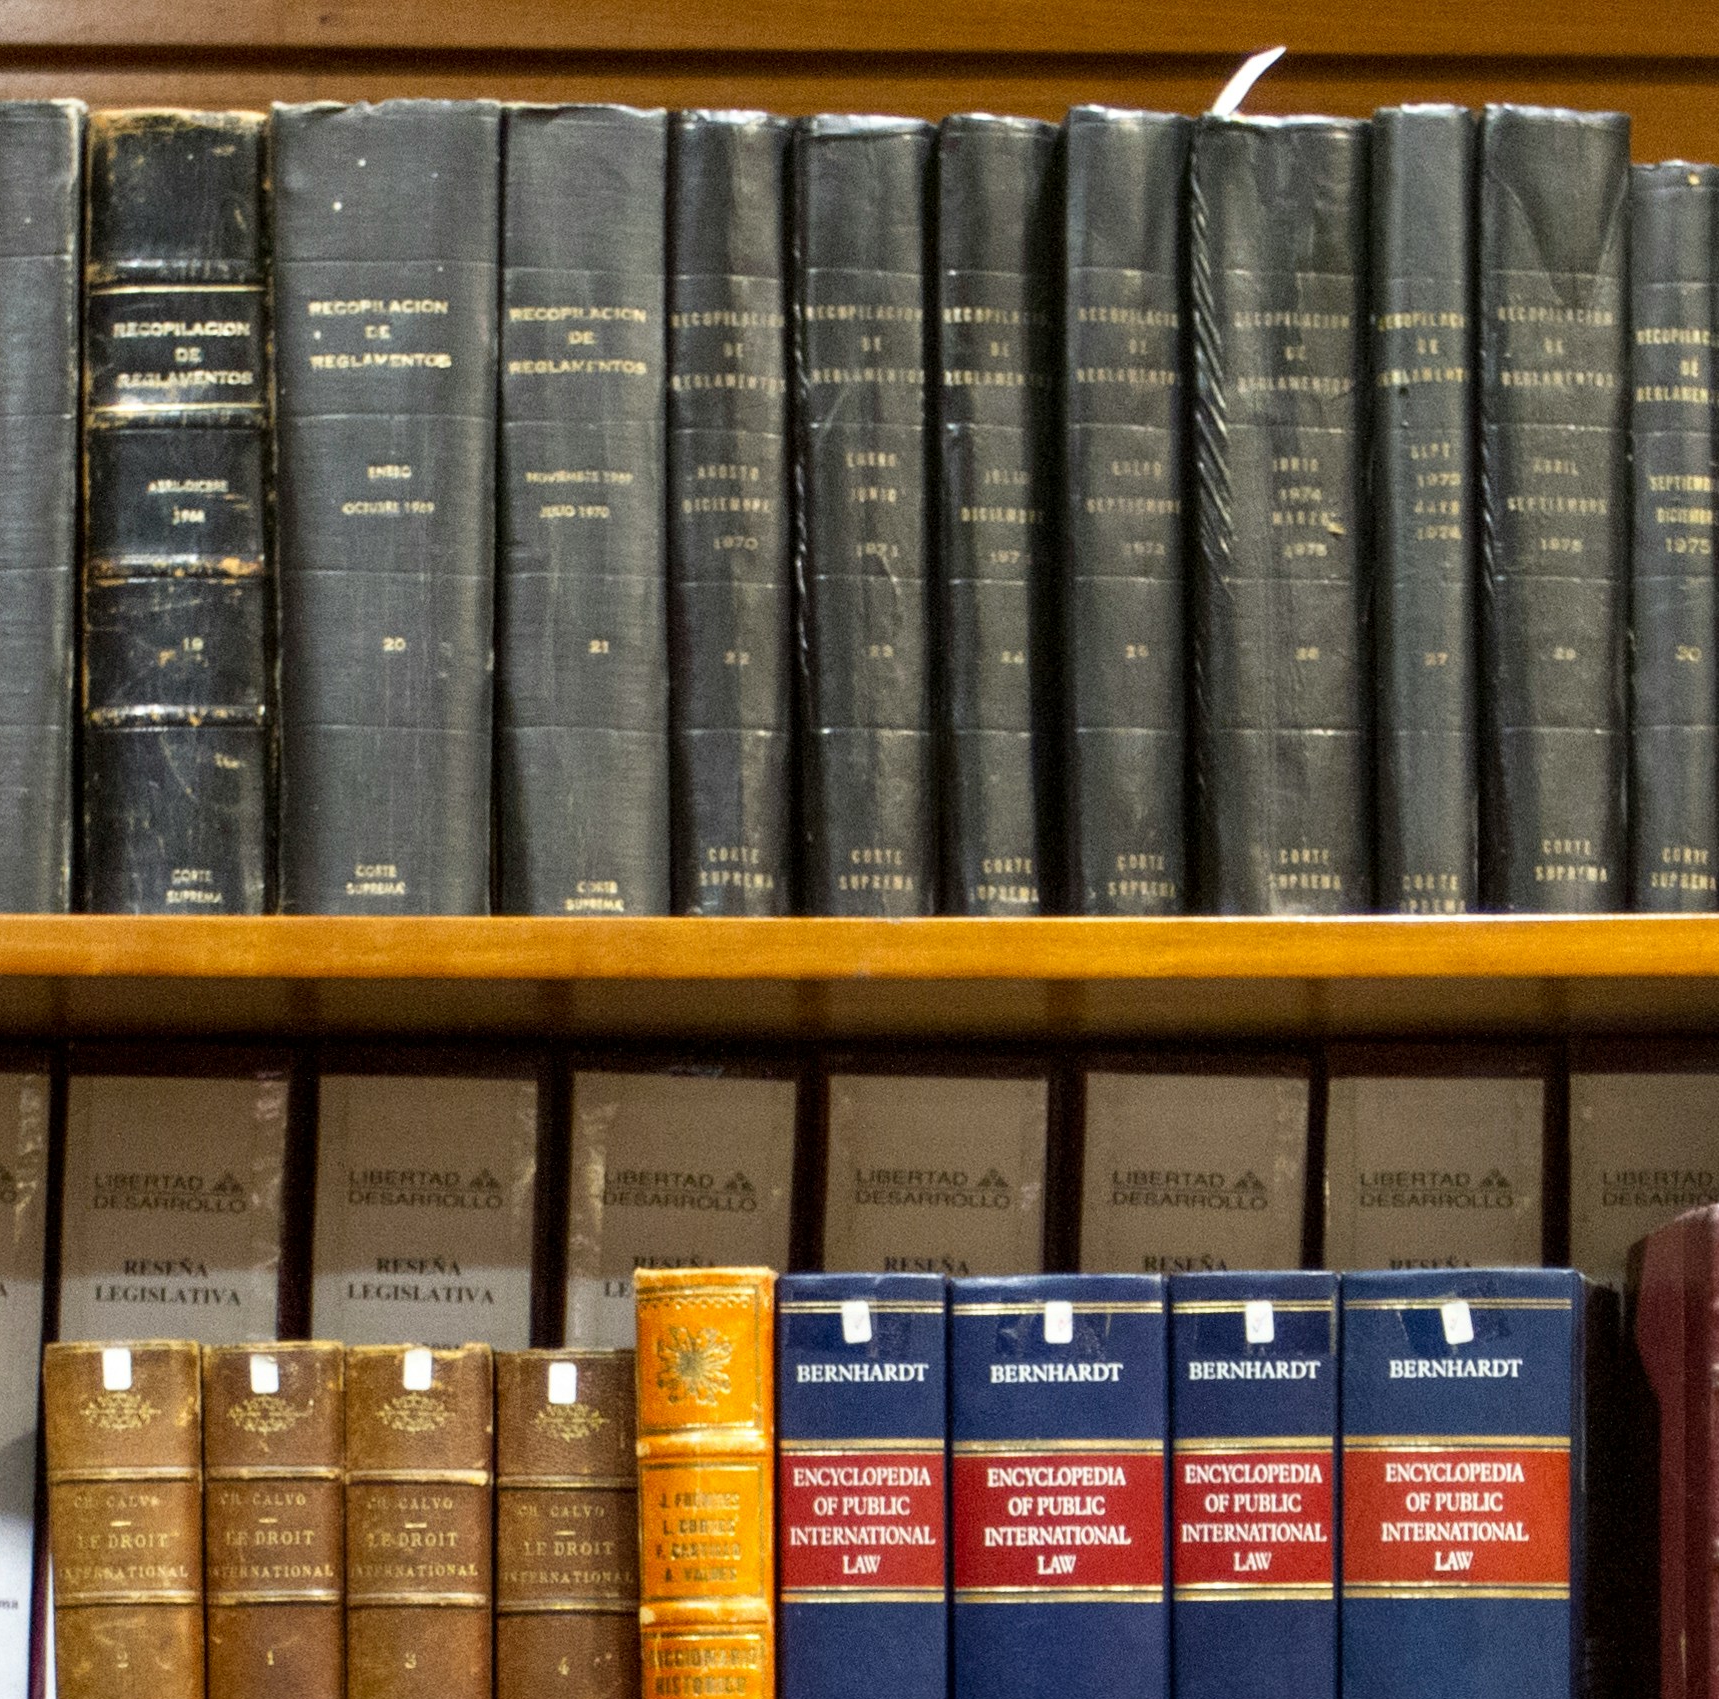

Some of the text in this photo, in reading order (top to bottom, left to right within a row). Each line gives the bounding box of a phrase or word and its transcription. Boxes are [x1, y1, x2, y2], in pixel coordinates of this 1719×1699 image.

[384, 638, 406, 651] 20
[797, 1363, 929, 1382] BERNHARDT
[990, 1363, 1123, 1383] BERNHARDT
[1189, 1361, 1320, 1380] BERNHARDT
[1390, 1359, 1522, 1378] BERNHARDT
[794, 1467, 931, 1488] ENCYCLOPEDIA
[988, 1468, 1126, 1488] ENCYCLOPEDIA
[1185, 1465, 1322, 1484] ENCYCLOPEDIA
[1385, 1463, 1524, 1483] ENCYCLOPEDIA
[814, 1497, 910, 1516] OF PUBLIC
[1008, 1497, 1106, 1516] OF PUBLIC
[1205, 1494, 1301, 1512] OF PUBLIC
[1406, 1492, 1503, 1511] OF PUBLIC
[790, 1526, 935, 1545] INTERNATIONAL
[984, 1526, 1131, 1546] INTERNATIONAL
[1182, 1523, 1327, 1542] INTERNATIONAL
[1382, 1522, 1529, 1542] INTERNATIONAL
[843, 1556, 881, 1575] LAW
[1038, 1556, 1076, 1575] LAW
[1234, 1552, 1272, 1571] LAW
[1435, 1551, 1473, 1571] LAW
